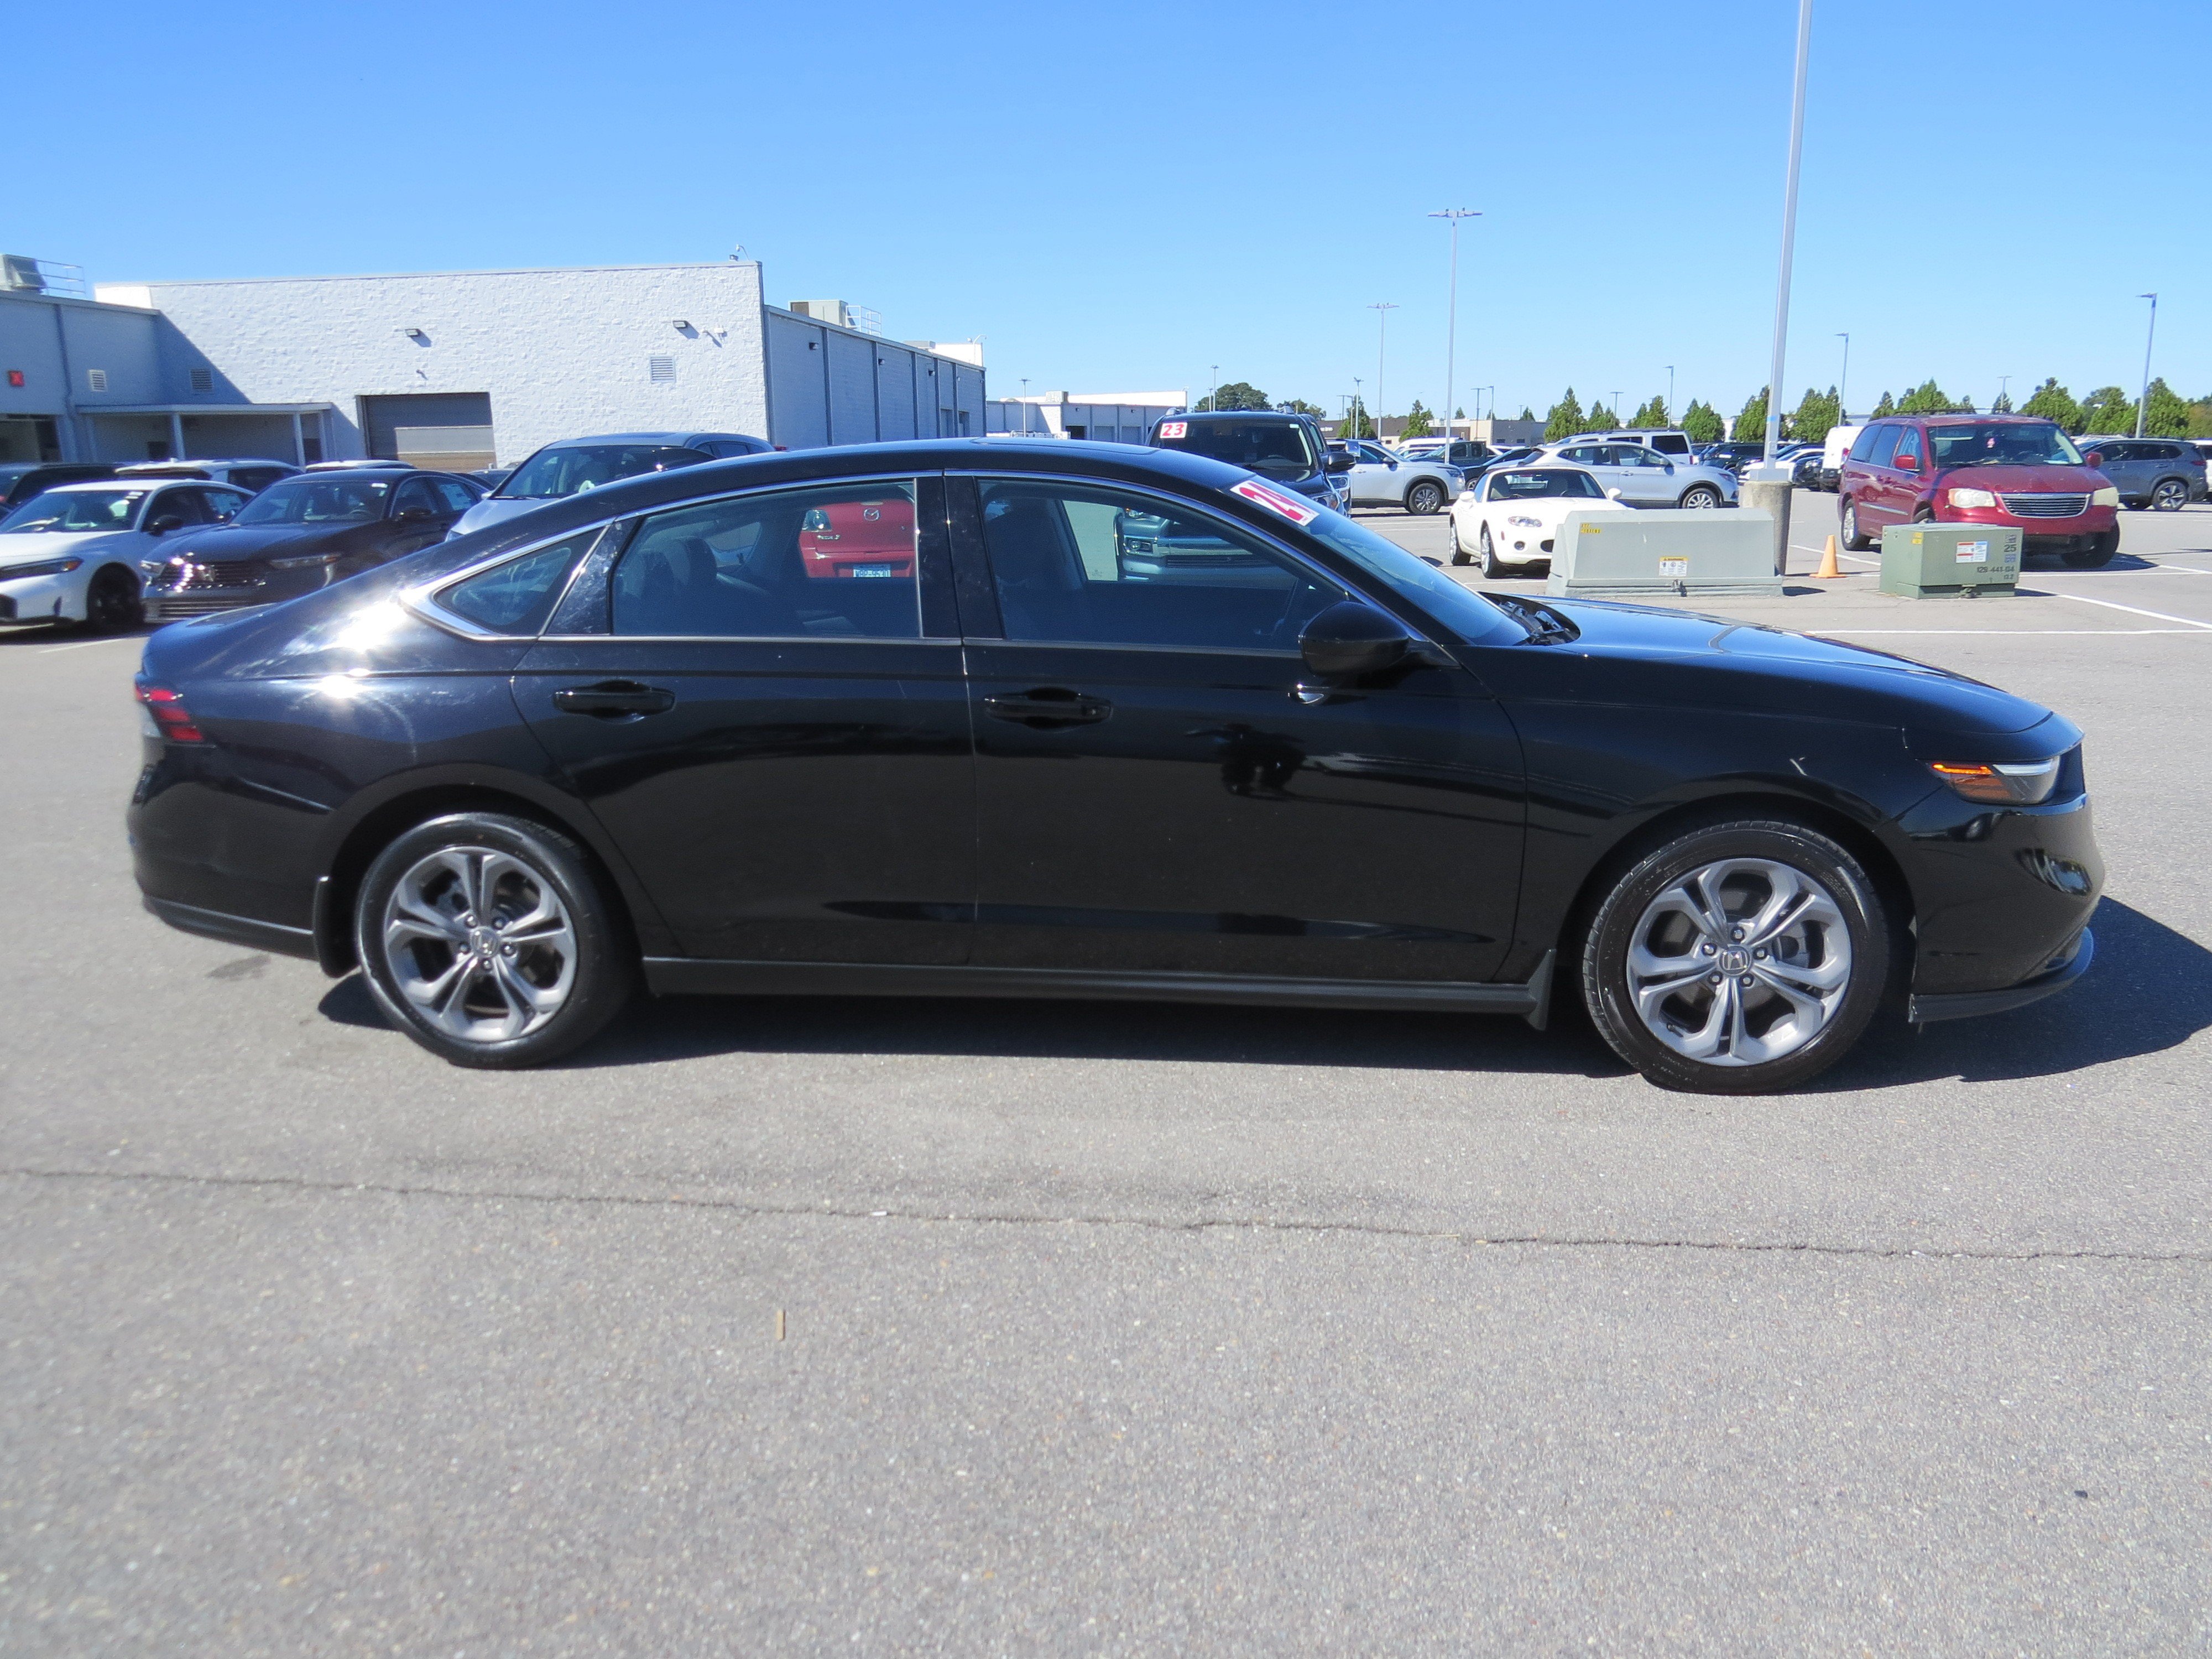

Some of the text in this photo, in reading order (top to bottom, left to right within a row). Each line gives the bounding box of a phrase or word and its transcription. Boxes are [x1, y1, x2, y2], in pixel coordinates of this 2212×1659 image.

[1162, 423, 1185, 437] 23
[1239, 482, 1314, 521] 24
[2004, 544, 2017, 552] 25
